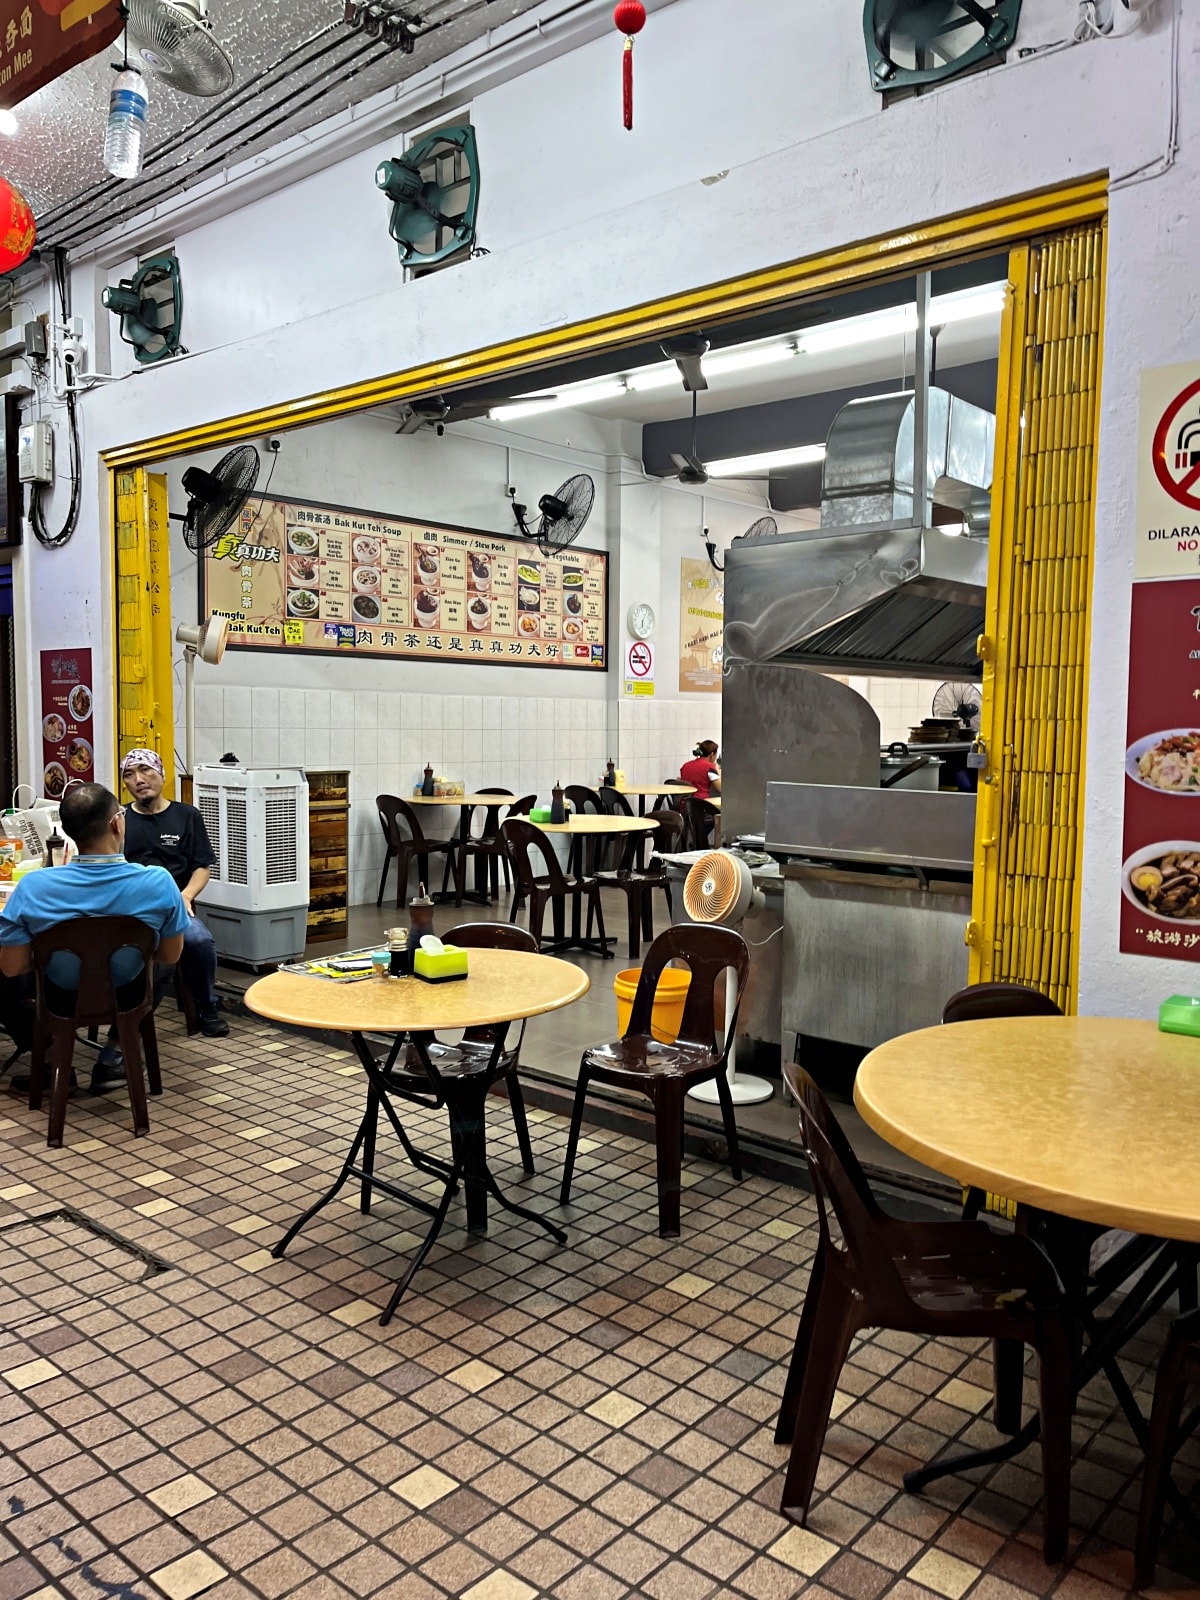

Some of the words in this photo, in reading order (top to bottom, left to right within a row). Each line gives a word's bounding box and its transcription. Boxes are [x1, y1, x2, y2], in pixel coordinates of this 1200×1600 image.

[14, 49, 32, 75] Mee
[298, 511, 331, 525] 肉骨茶汤
[335, 518, 349, 528] Bak
[352, 521, 365, 530] Kut
[368, 524, 380, 532] Teh
[383, 526, 402, 536] Soup
[1148, 525, 1200, 540] DILARA
[443, 535, 468, 546] Simmer
[475, 541, 490, 549] Stew
[491, 544, 506, 552] Pork
[1178, 540, 1198, 552] NO
[212, 610, 245, 621] Kungfu
[228, 623, 244, 632] Bak
[247, 624, 263, 634] Kut
[265, 626, 280, 635] Teh
[356, 629, 560, 658] 肉骨茶还是真真功夫好
